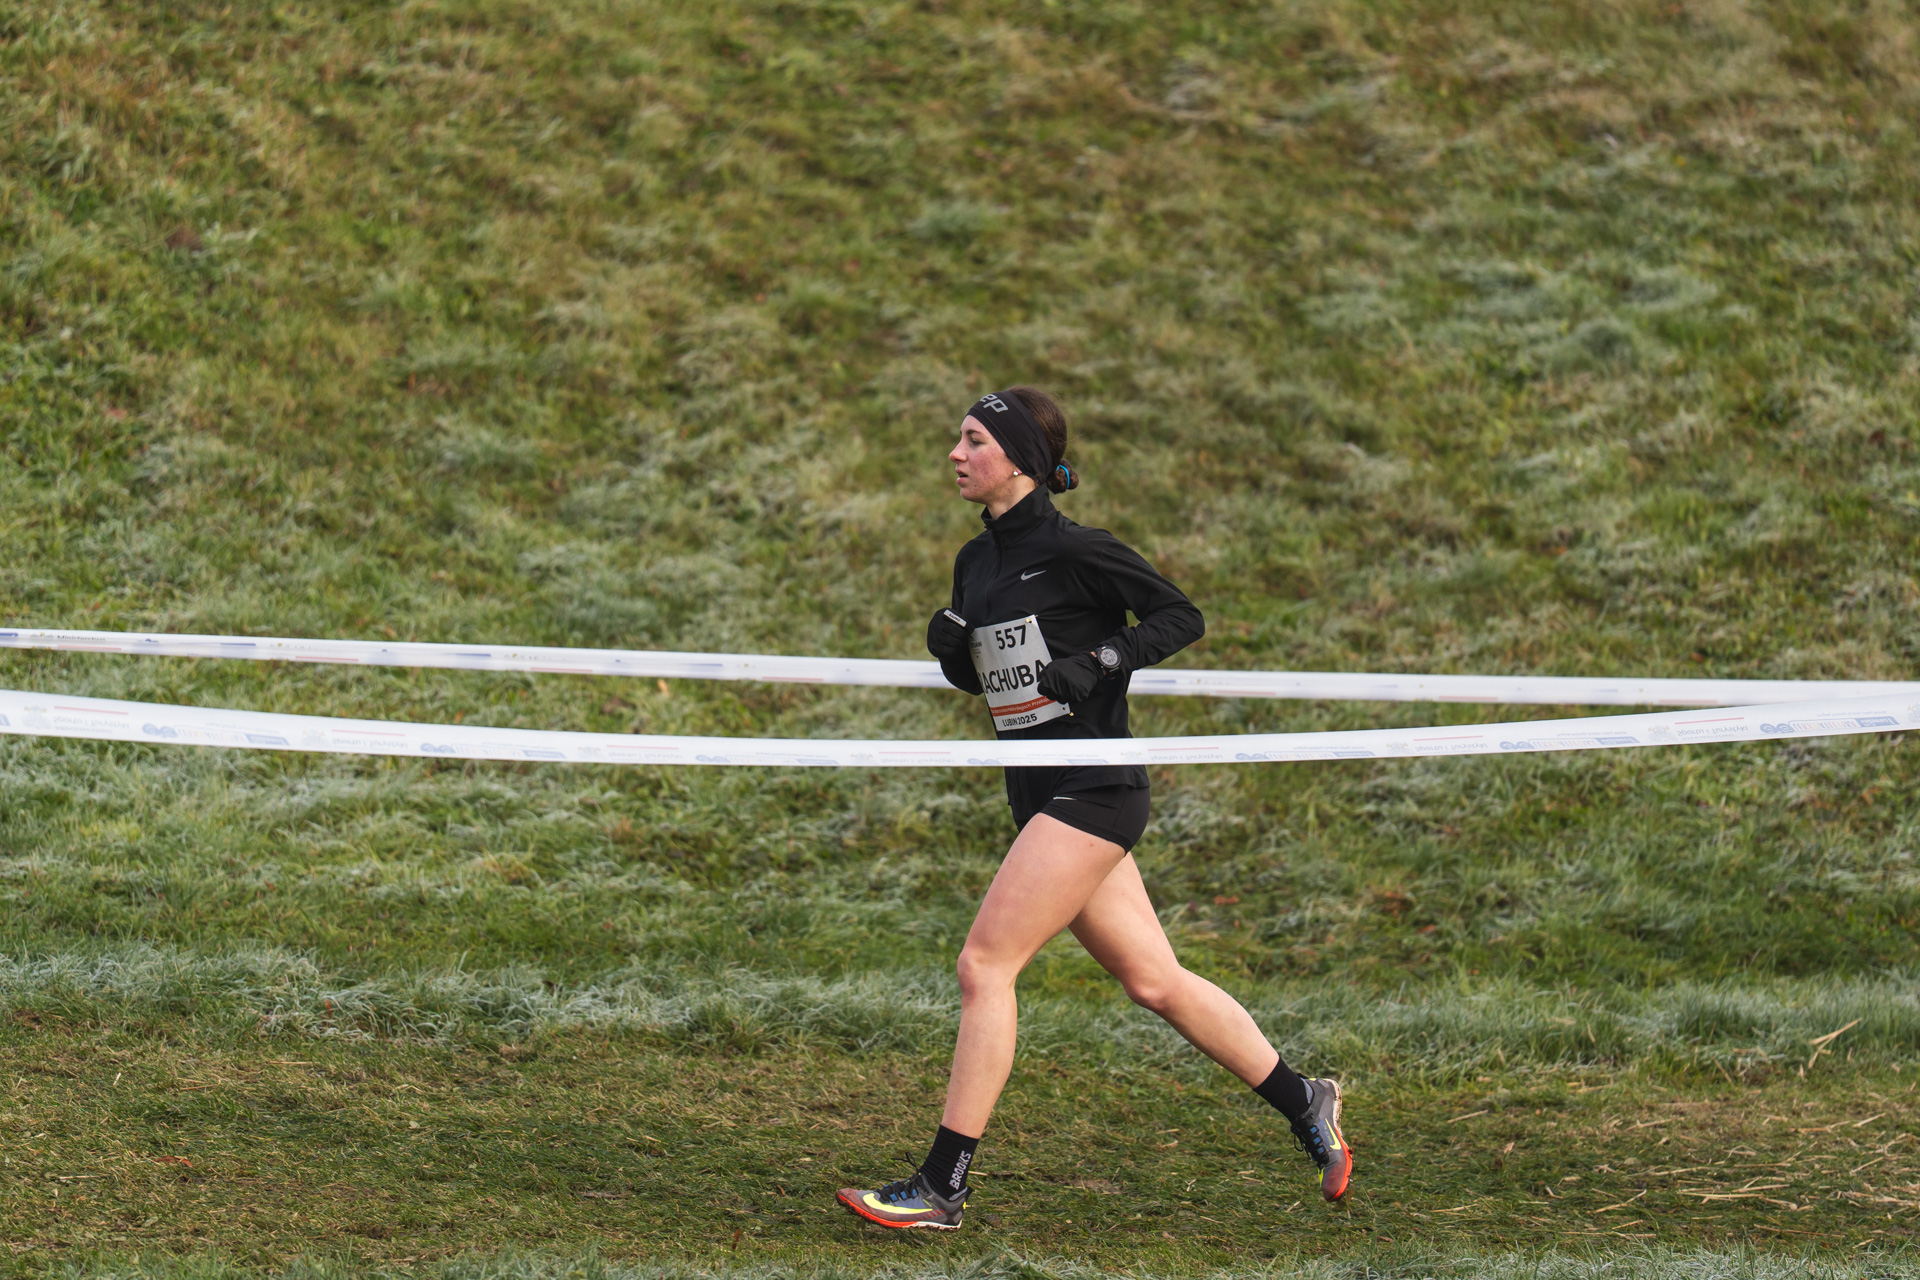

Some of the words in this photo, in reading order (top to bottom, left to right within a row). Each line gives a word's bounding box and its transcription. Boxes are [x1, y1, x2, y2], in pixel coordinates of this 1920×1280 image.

[995, 624, 1027, 650] 557
[978, 659, 1046, 694] ACHUBA
[949, 1150, 972, 1190] BROOKS
